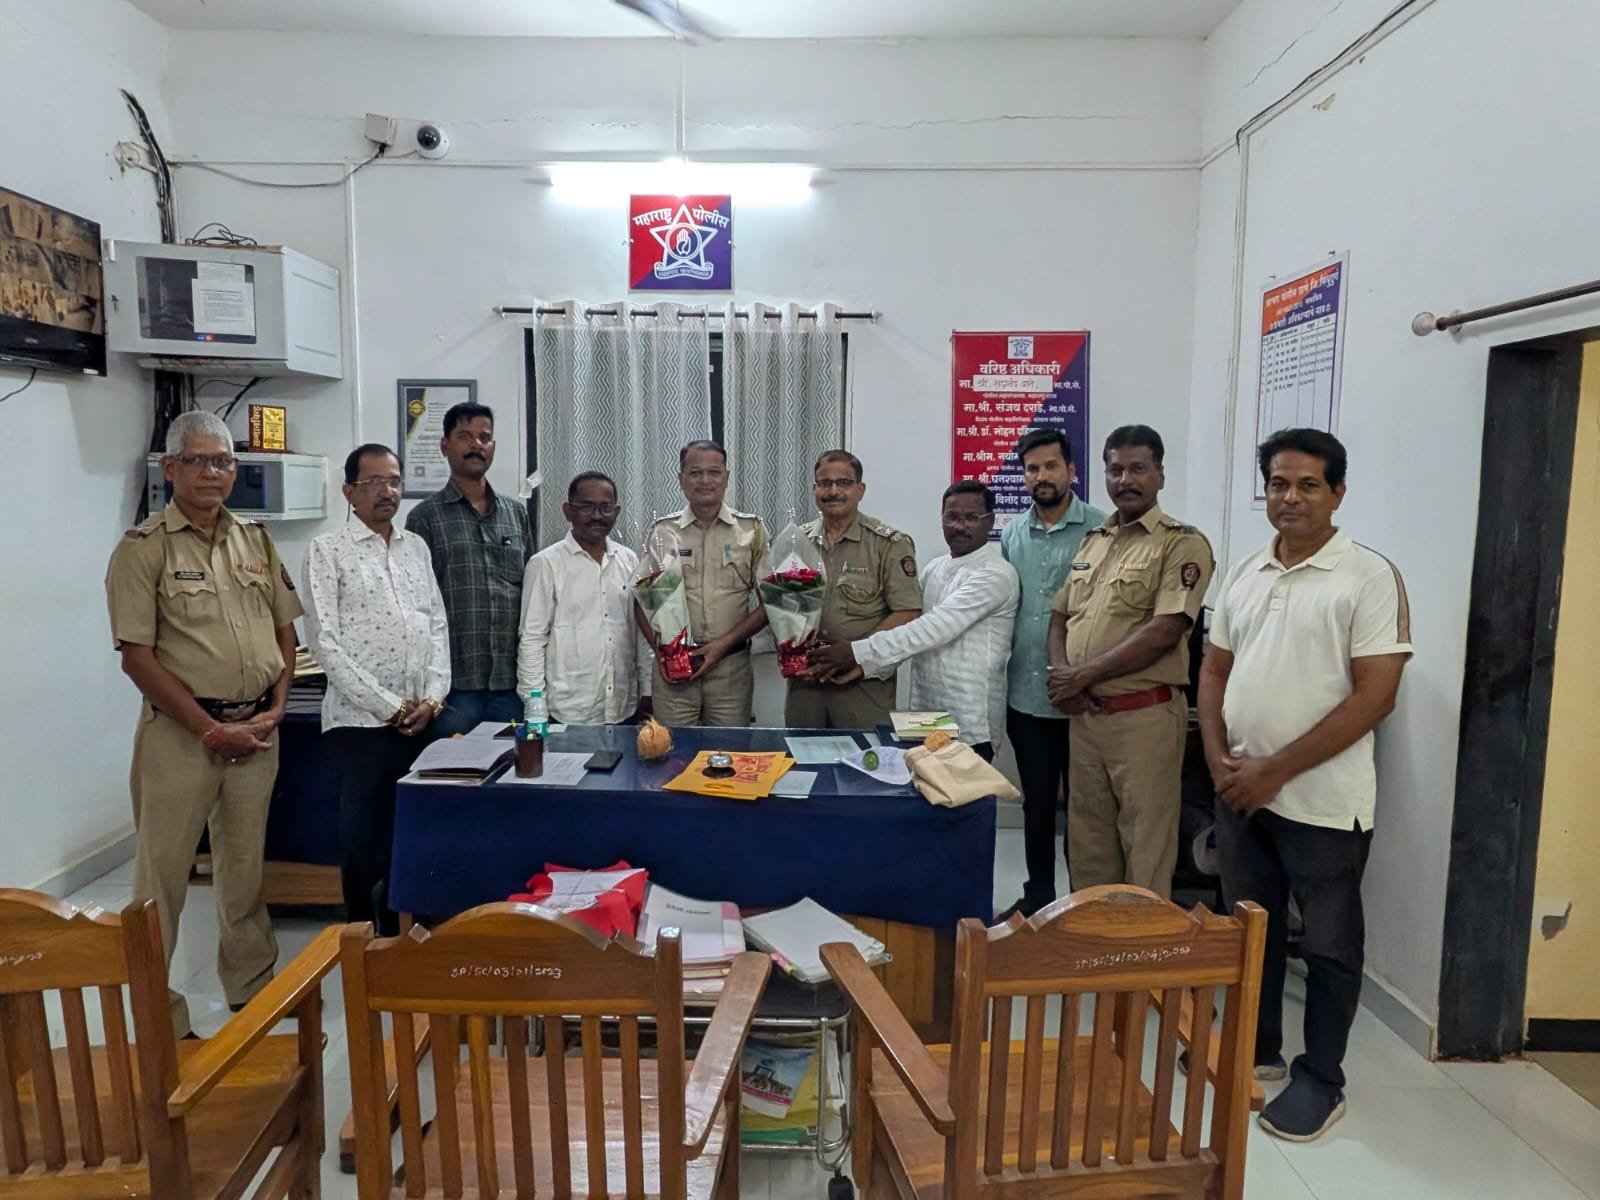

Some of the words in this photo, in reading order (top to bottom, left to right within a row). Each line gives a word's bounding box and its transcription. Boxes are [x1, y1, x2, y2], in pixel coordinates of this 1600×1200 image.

[632, 208, 672, 226] महाराष्ट्र
[692, 205, 730, 228] पोलीस
[979, 360, 1008, 375] वरिष्ठ
[1010, 360, 1061, 375] अधिकारी
[995, 400, 1021, 413] संजय
[993, 425, 1016, 437] मोहन
[995, 493, 1019, 505] विनोद
